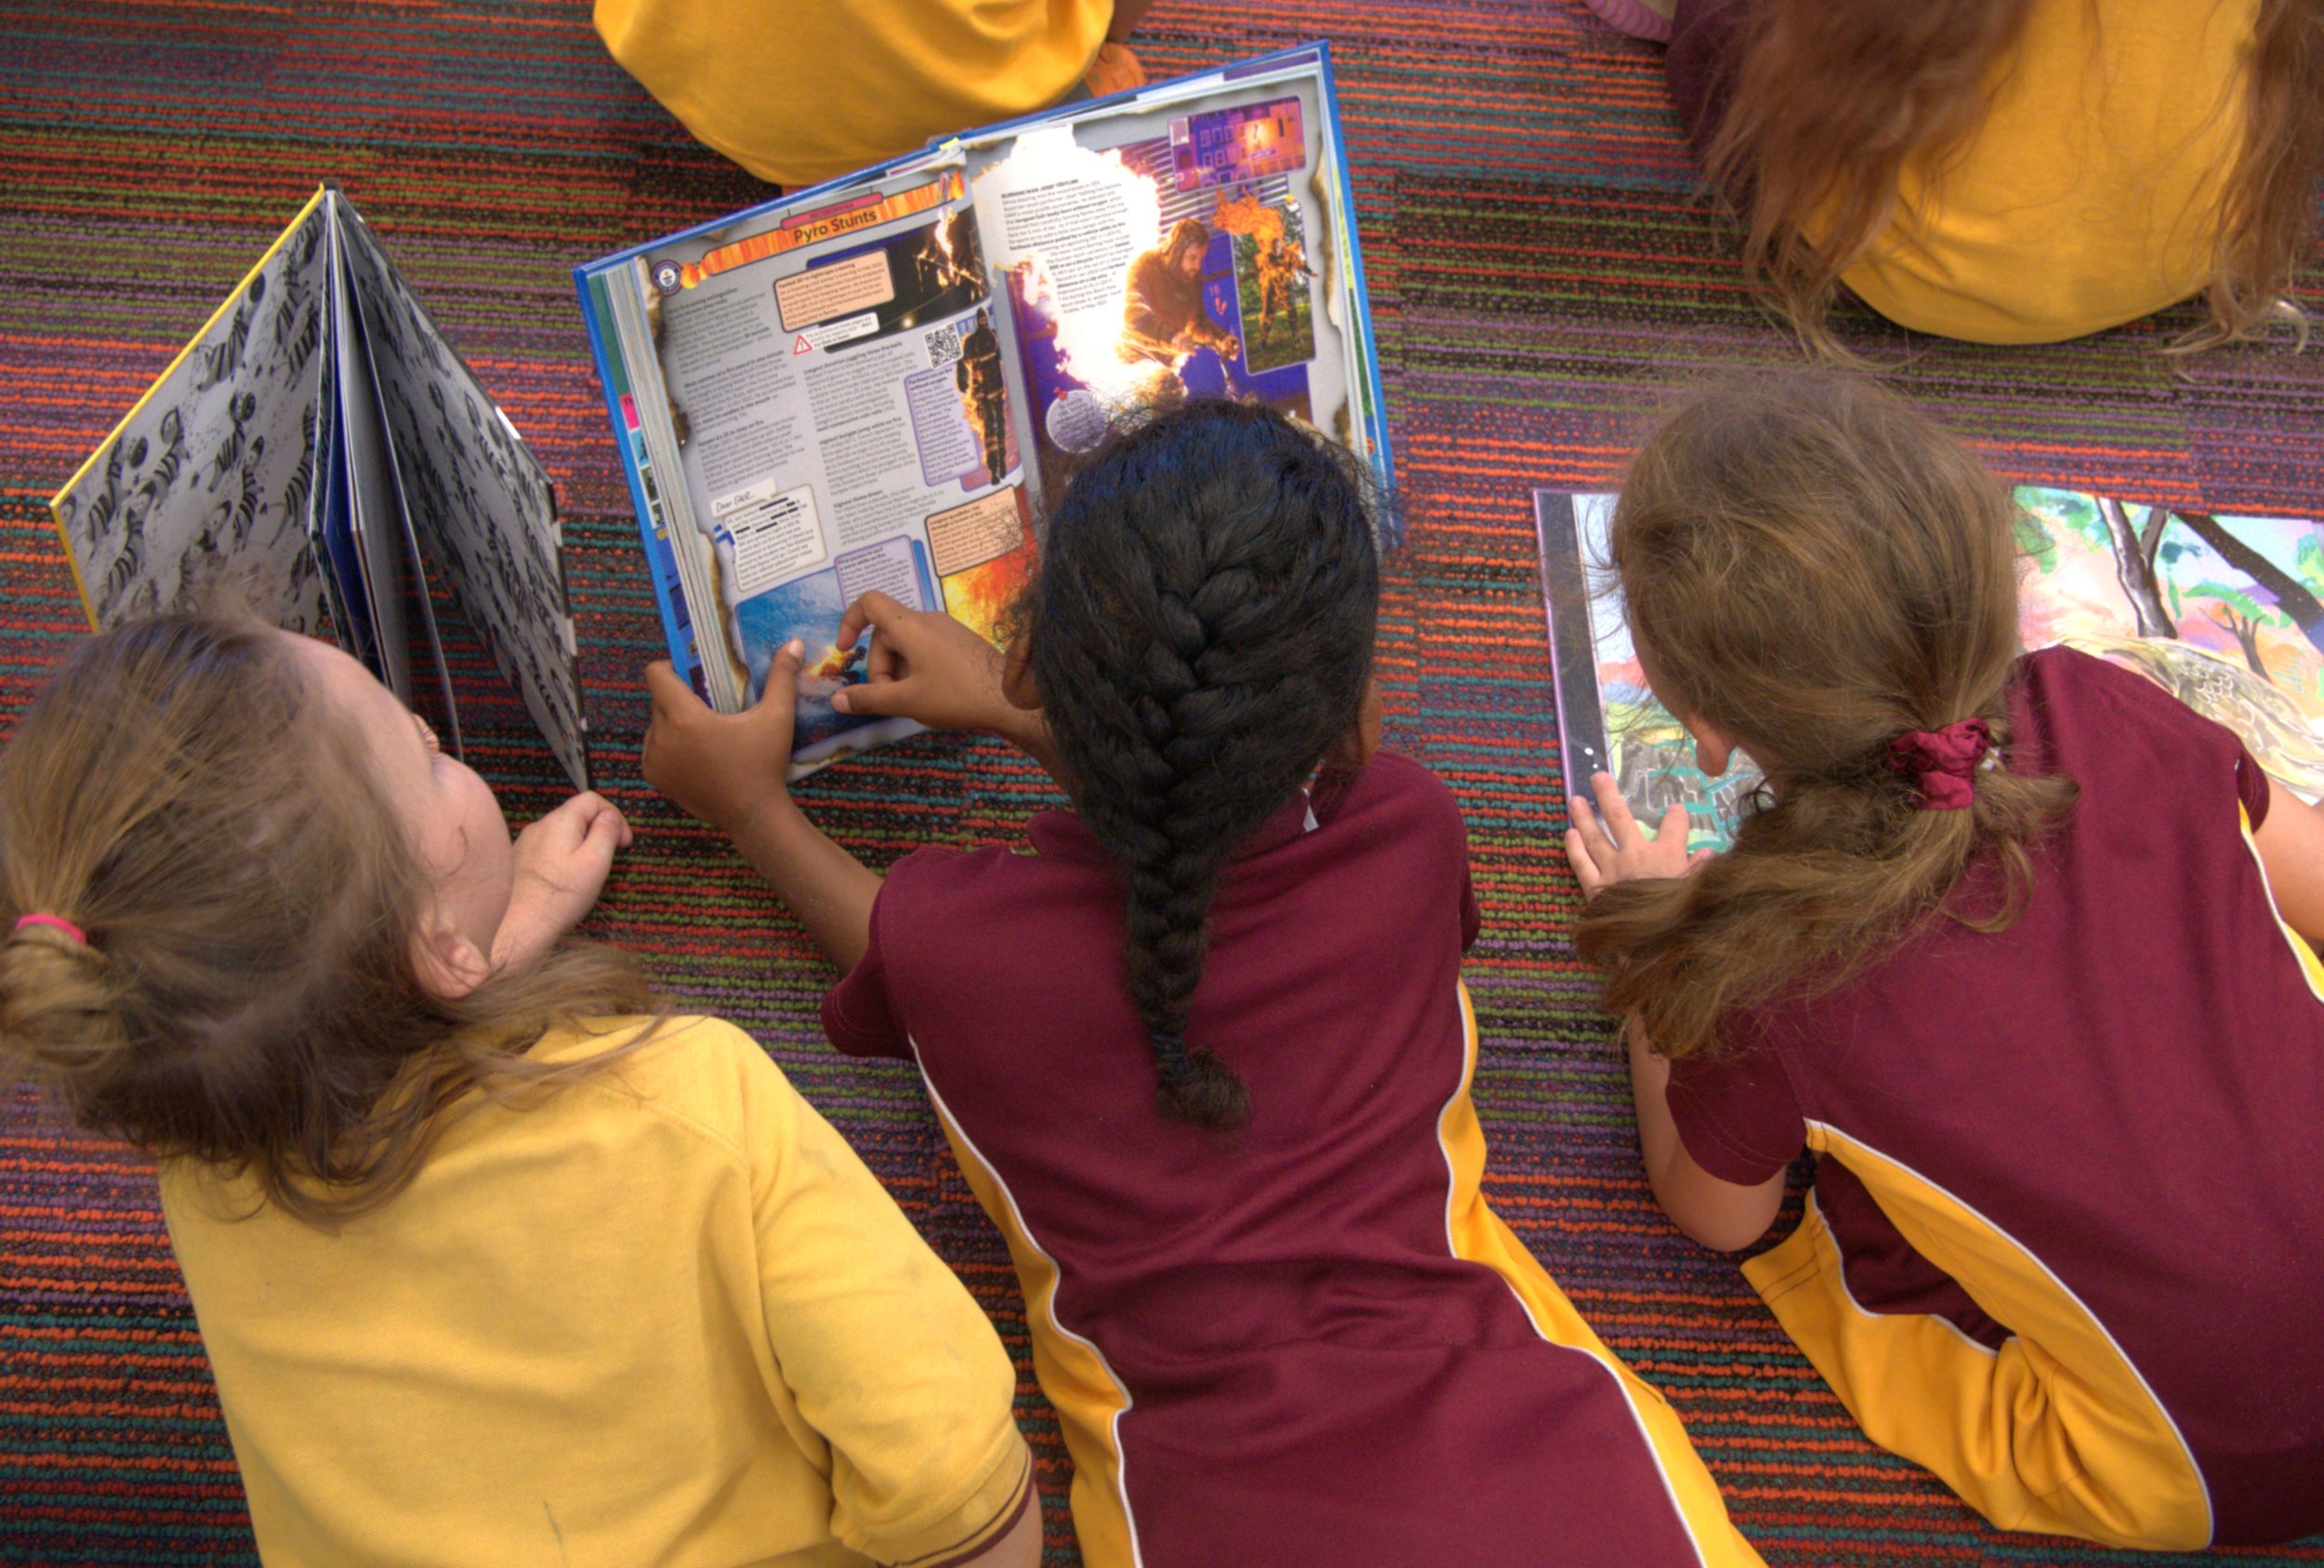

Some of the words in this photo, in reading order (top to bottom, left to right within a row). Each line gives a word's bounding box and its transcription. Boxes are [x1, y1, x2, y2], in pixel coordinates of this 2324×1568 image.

[792, 220, 829, 245] Pyro
[829, 206, 877, 233] Stunts
[714, 497, 733, 513] Dear
